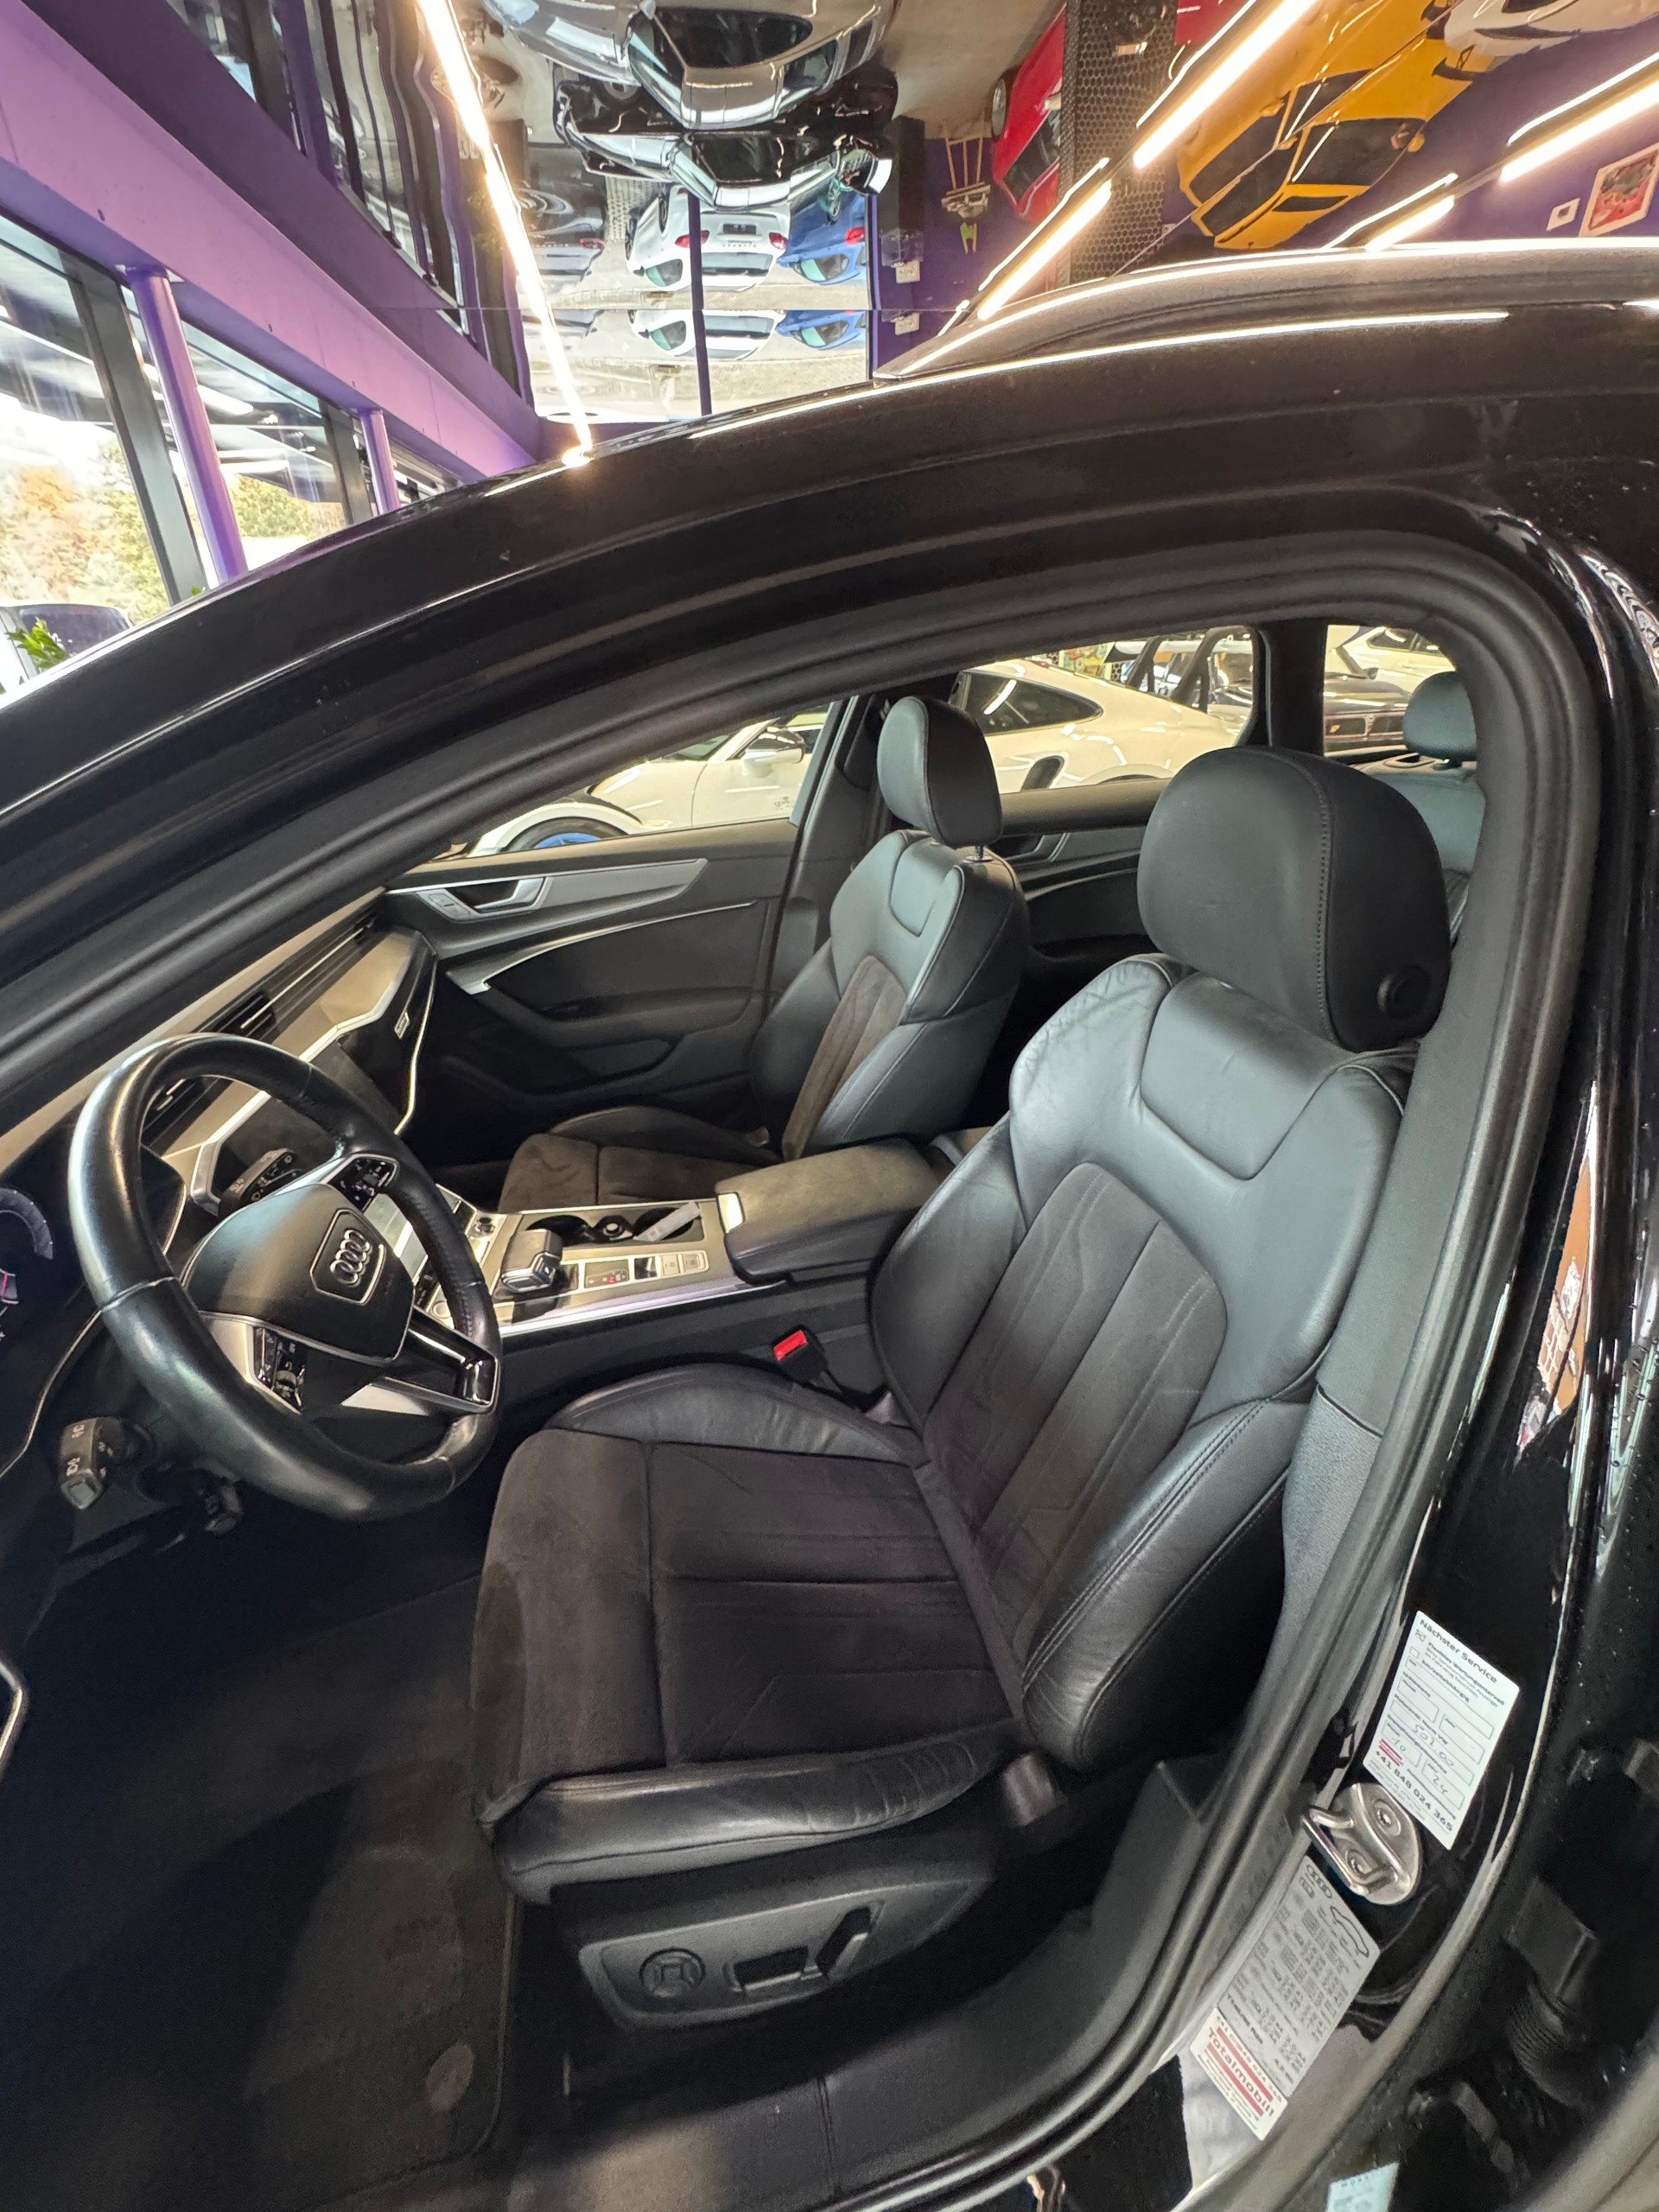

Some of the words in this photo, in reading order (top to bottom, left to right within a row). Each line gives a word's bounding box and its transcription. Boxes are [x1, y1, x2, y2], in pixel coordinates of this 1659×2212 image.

[1419, 1618, 1460, 1655] Nächster
[1460, 1650, 1497, 1684] Service
[1374, 1748, 1392, 1770] +41
[1393, 1768, 1412, 1789] 848
[1413, 1787, 1432, 1810] 024
[1433, 1808, 1453, 1833] 365
[1205, 2025, 1274, 2118] Totalmobil!
